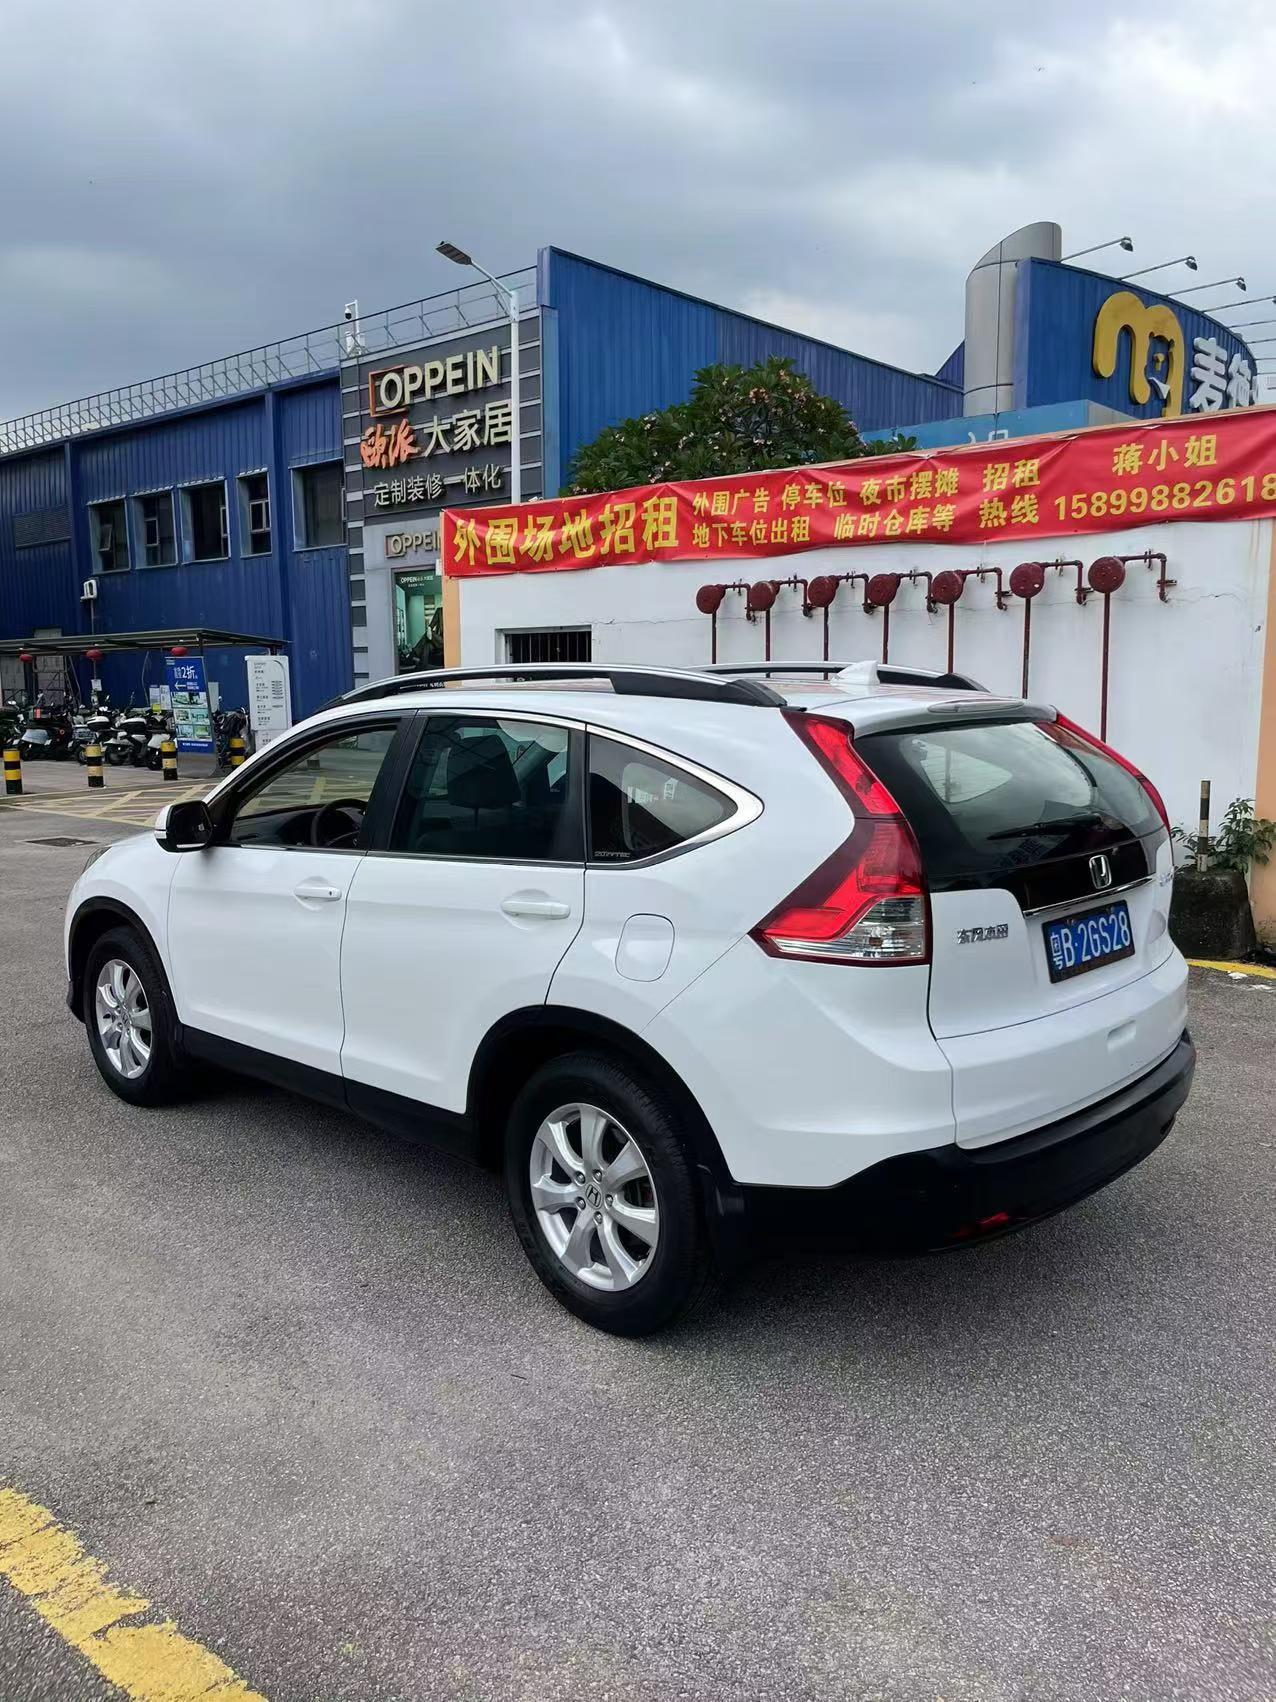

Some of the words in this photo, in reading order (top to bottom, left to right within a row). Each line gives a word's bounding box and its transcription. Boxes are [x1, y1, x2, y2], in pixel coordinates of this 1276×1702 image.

[380, 345, 500, 409] OPPEIN
[1189, 337, 1259, 412] 麦德
[1111, 434, 1218, 477] 蒋小姐
[373, 463, 502, 508] 定制装修一体化
[692, 487, 771, 517] 外围广告
[781, 480, 848, 511] 停车位
[859, 467, 960, 506] 夜市摆摊
[982, 458, 1041, 493] 招租
[1054, 473, 1276, 521] 15899882618
[452, 496, 680, 566] 外围场地招租
[692, 515, 811, 548] 地下车位出租
[833, 503, 957, 540] 临时仓库等
[978, 493, 1040, 529] 热线
